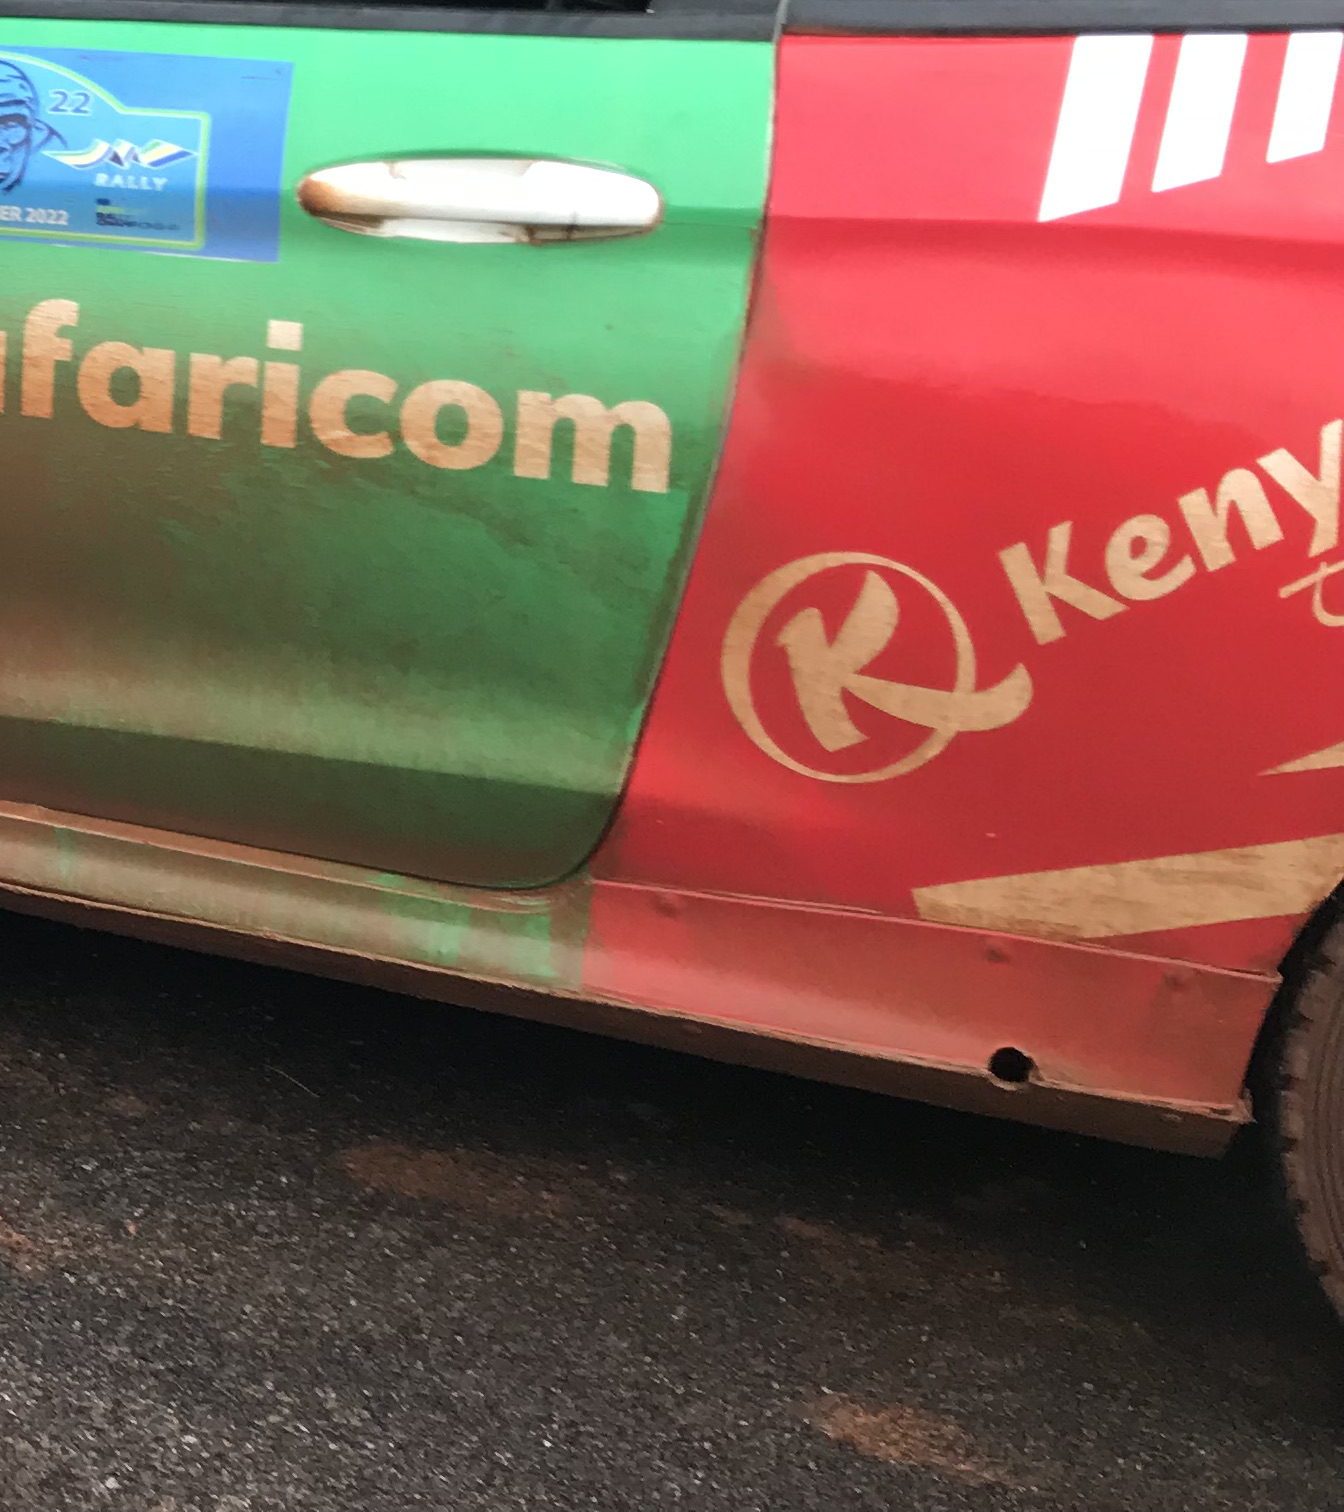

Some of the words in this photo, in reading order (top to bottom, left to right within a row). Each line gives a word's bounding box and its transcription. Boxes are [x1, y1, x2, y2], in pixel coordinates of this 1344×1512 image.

[48, 90, 92, 115] 22
[94, 173, 169, 191] RALLY
[25, 207, 70, 226] 2022
[998, 419, 1343, 646] Keny
